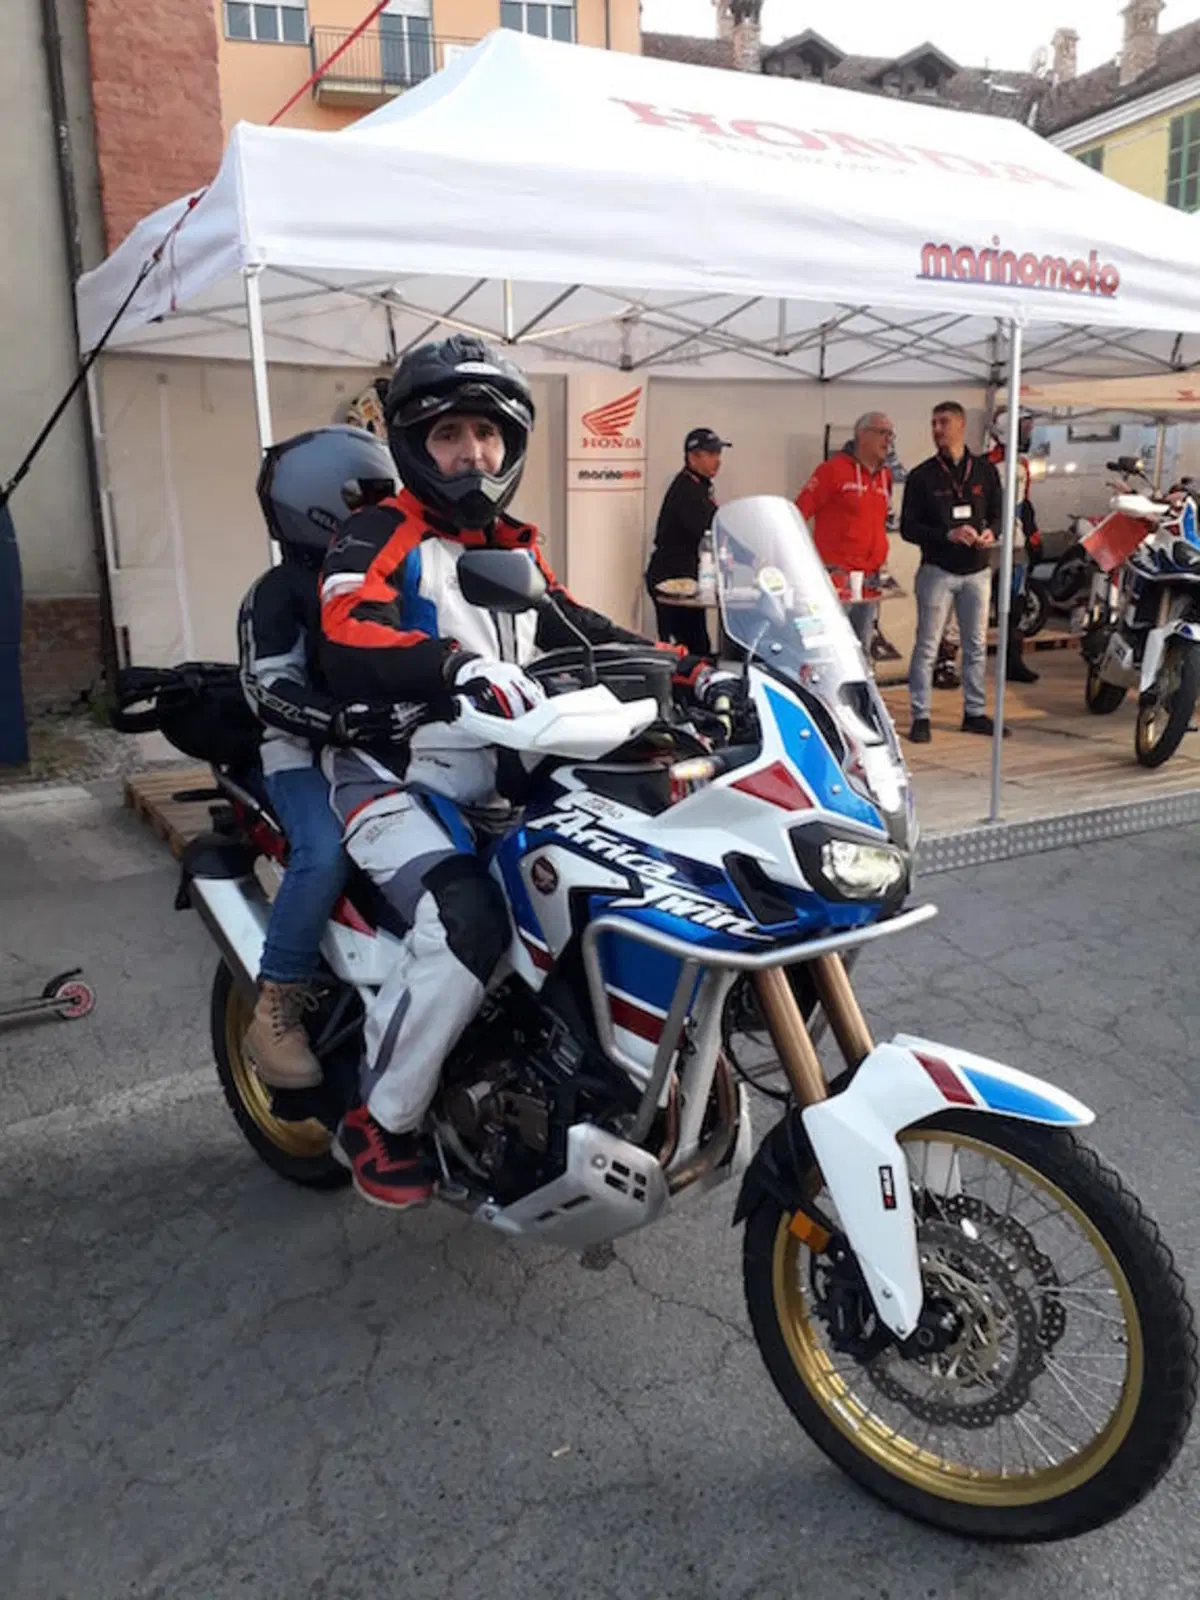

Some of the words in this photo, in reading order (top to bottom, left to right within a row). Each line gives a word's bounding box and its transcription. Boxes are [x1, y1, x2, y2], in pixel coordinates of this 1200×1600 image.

[609, 97, 1078, 190] HONDA
[920, 236, 1121, 297] marinomoto
[582, 437, 642, 449] HONDA
[525, 808, 678, 880] Africa
[608, 874, 776, 941] Twin
